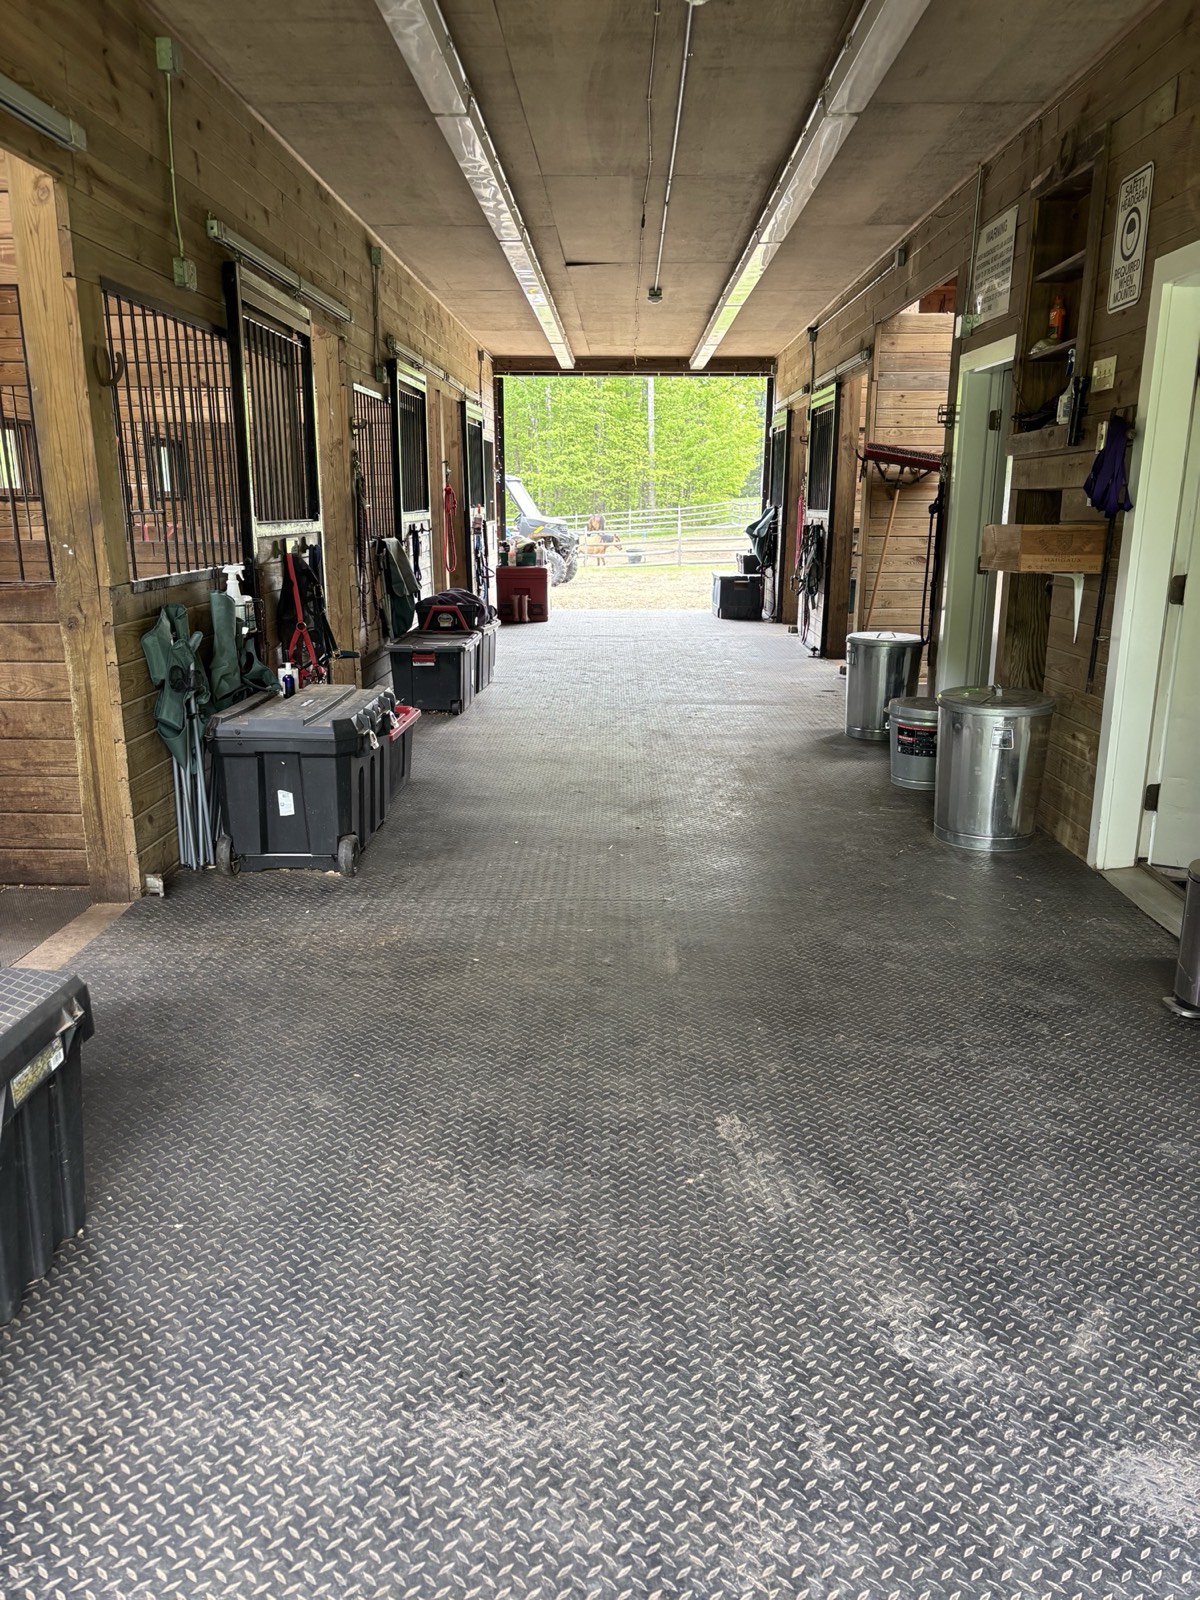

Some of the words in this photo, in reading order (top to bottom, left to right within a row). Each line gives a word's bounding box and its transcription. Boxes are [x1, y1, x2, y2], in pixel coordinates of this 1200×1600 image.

[1125, 175, 1146, 198] SAFETY
[1121, 185, 1148, 213] HEADGEAR
[986, 219, 1008, 244] WARNING
[1114, 258, 1140, 280] REQUIRED
[1119, 273, 1134, 290] WHEN
[1113, 284, 1136, 304] MOUNTED
